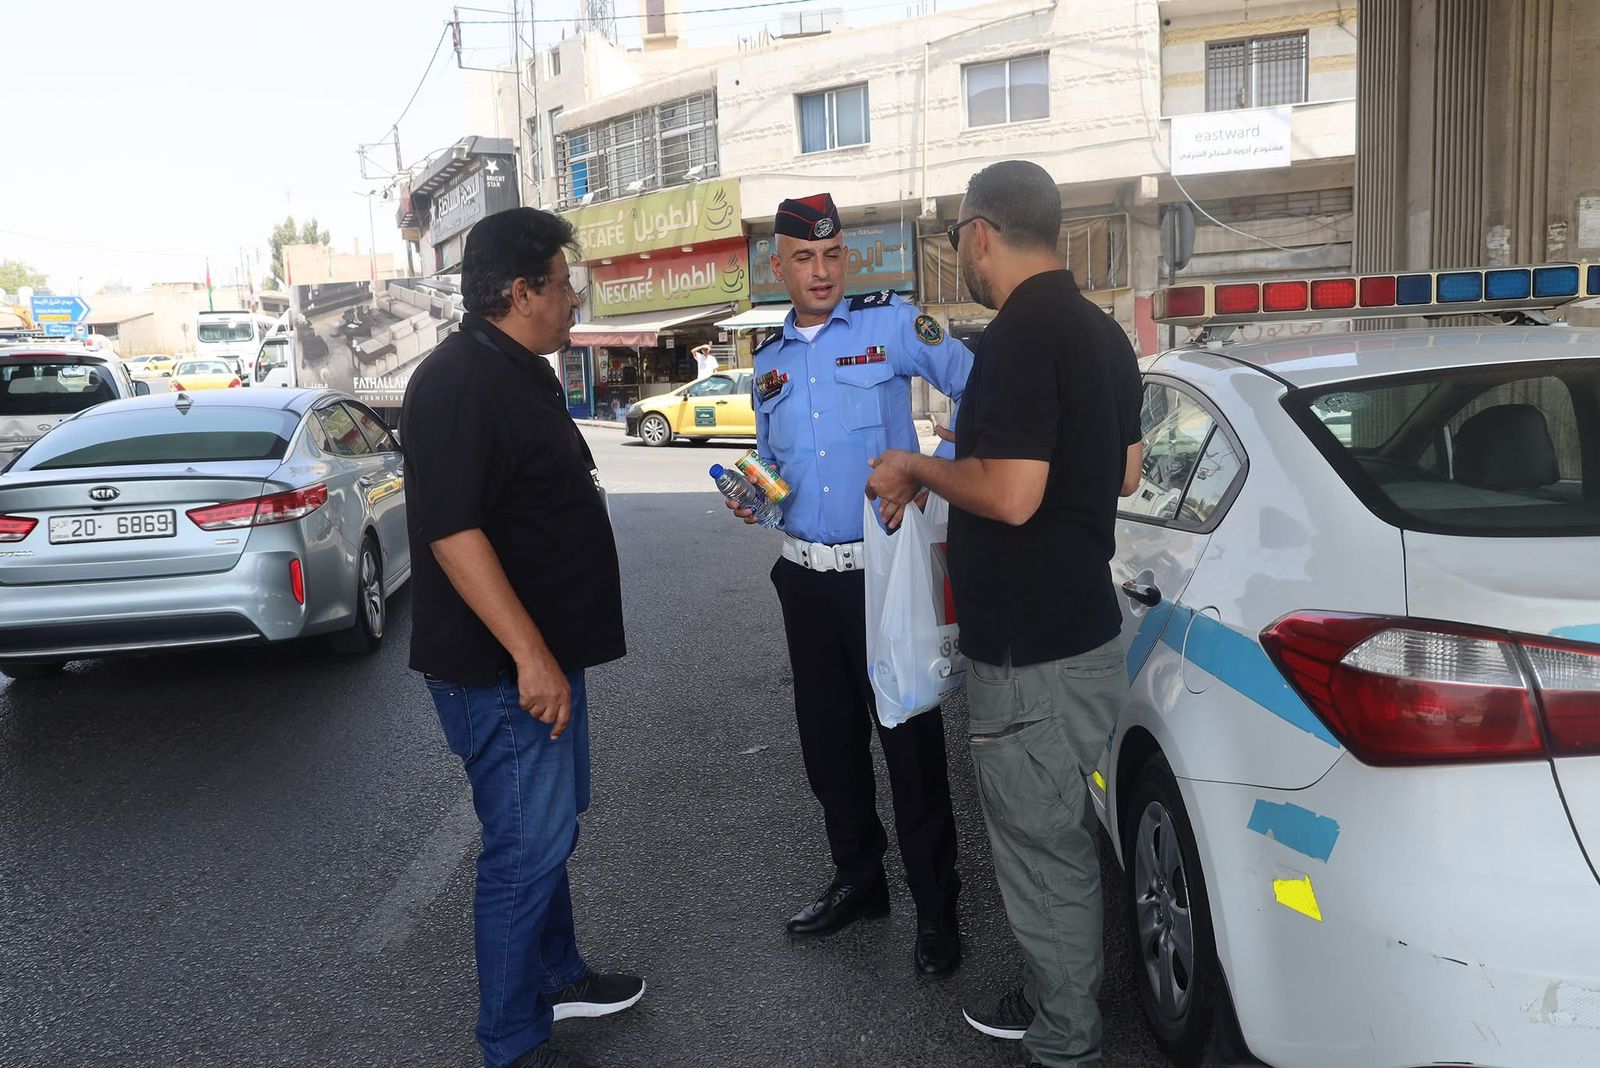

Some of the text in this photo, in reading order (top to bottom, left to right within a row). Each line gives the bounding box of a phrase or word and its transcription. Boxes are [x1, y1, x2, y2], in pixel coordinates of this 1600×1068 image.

[1195, 124, 1260, 142] eastward
[578, 210, 625, 250] SCAFÉ
[633, 200, 699, 242] الطويل
[661, 262, 716, 299] الطويل
[353, 376, 408, 389] FATHALLAH
[92, 489, 115, 499] KIA
[71, 514, 169, 537] 20 6869
